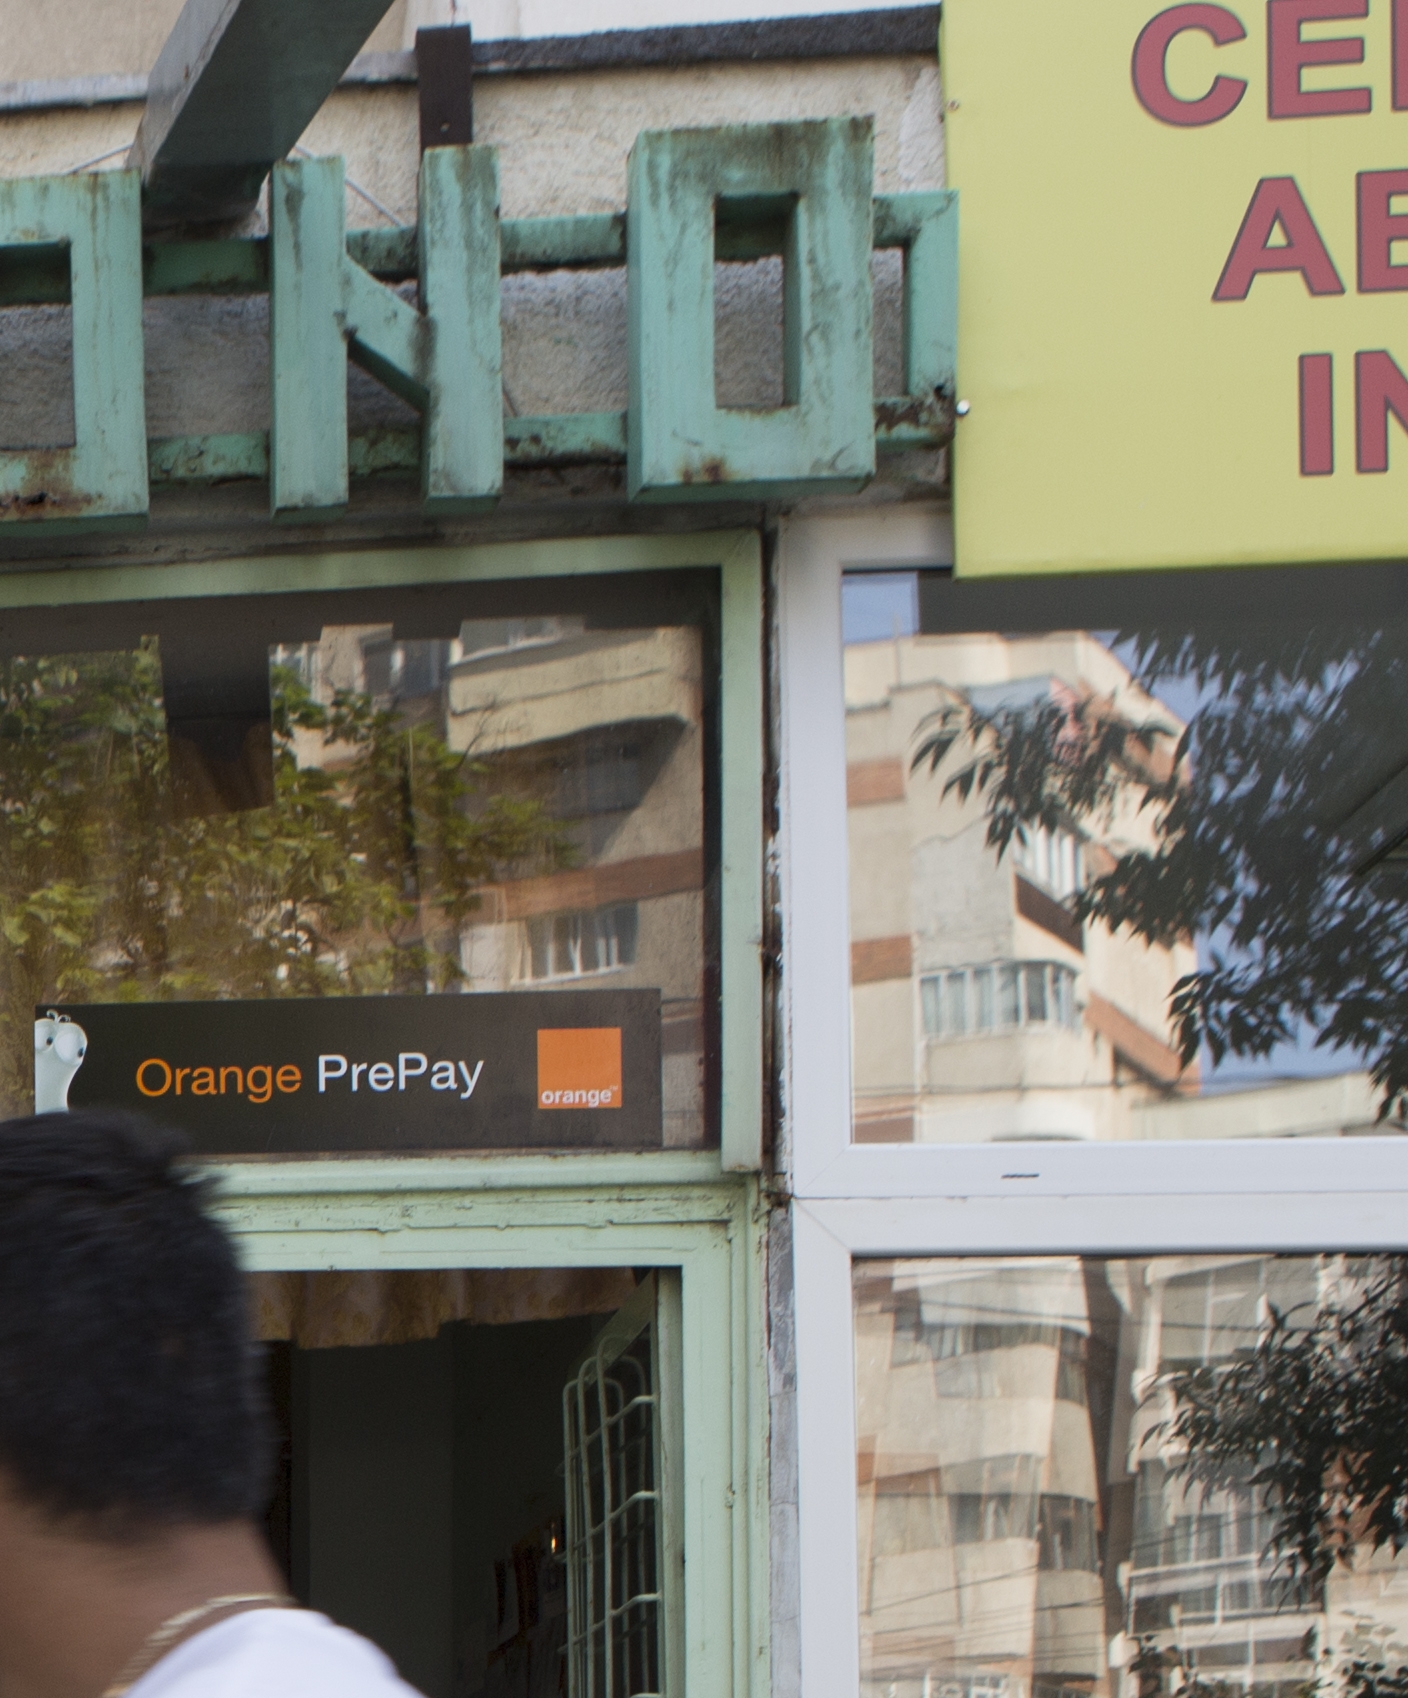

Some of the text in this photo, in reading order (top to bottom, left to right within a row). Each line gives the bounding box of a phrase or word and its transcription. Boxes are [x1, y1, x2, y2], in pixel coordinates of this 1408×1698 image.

[1131, 0, 1408, 129] CE
[135, 1052, 484, 1104] Orange PrePay
[541, 1086, 613, 1106] orange
